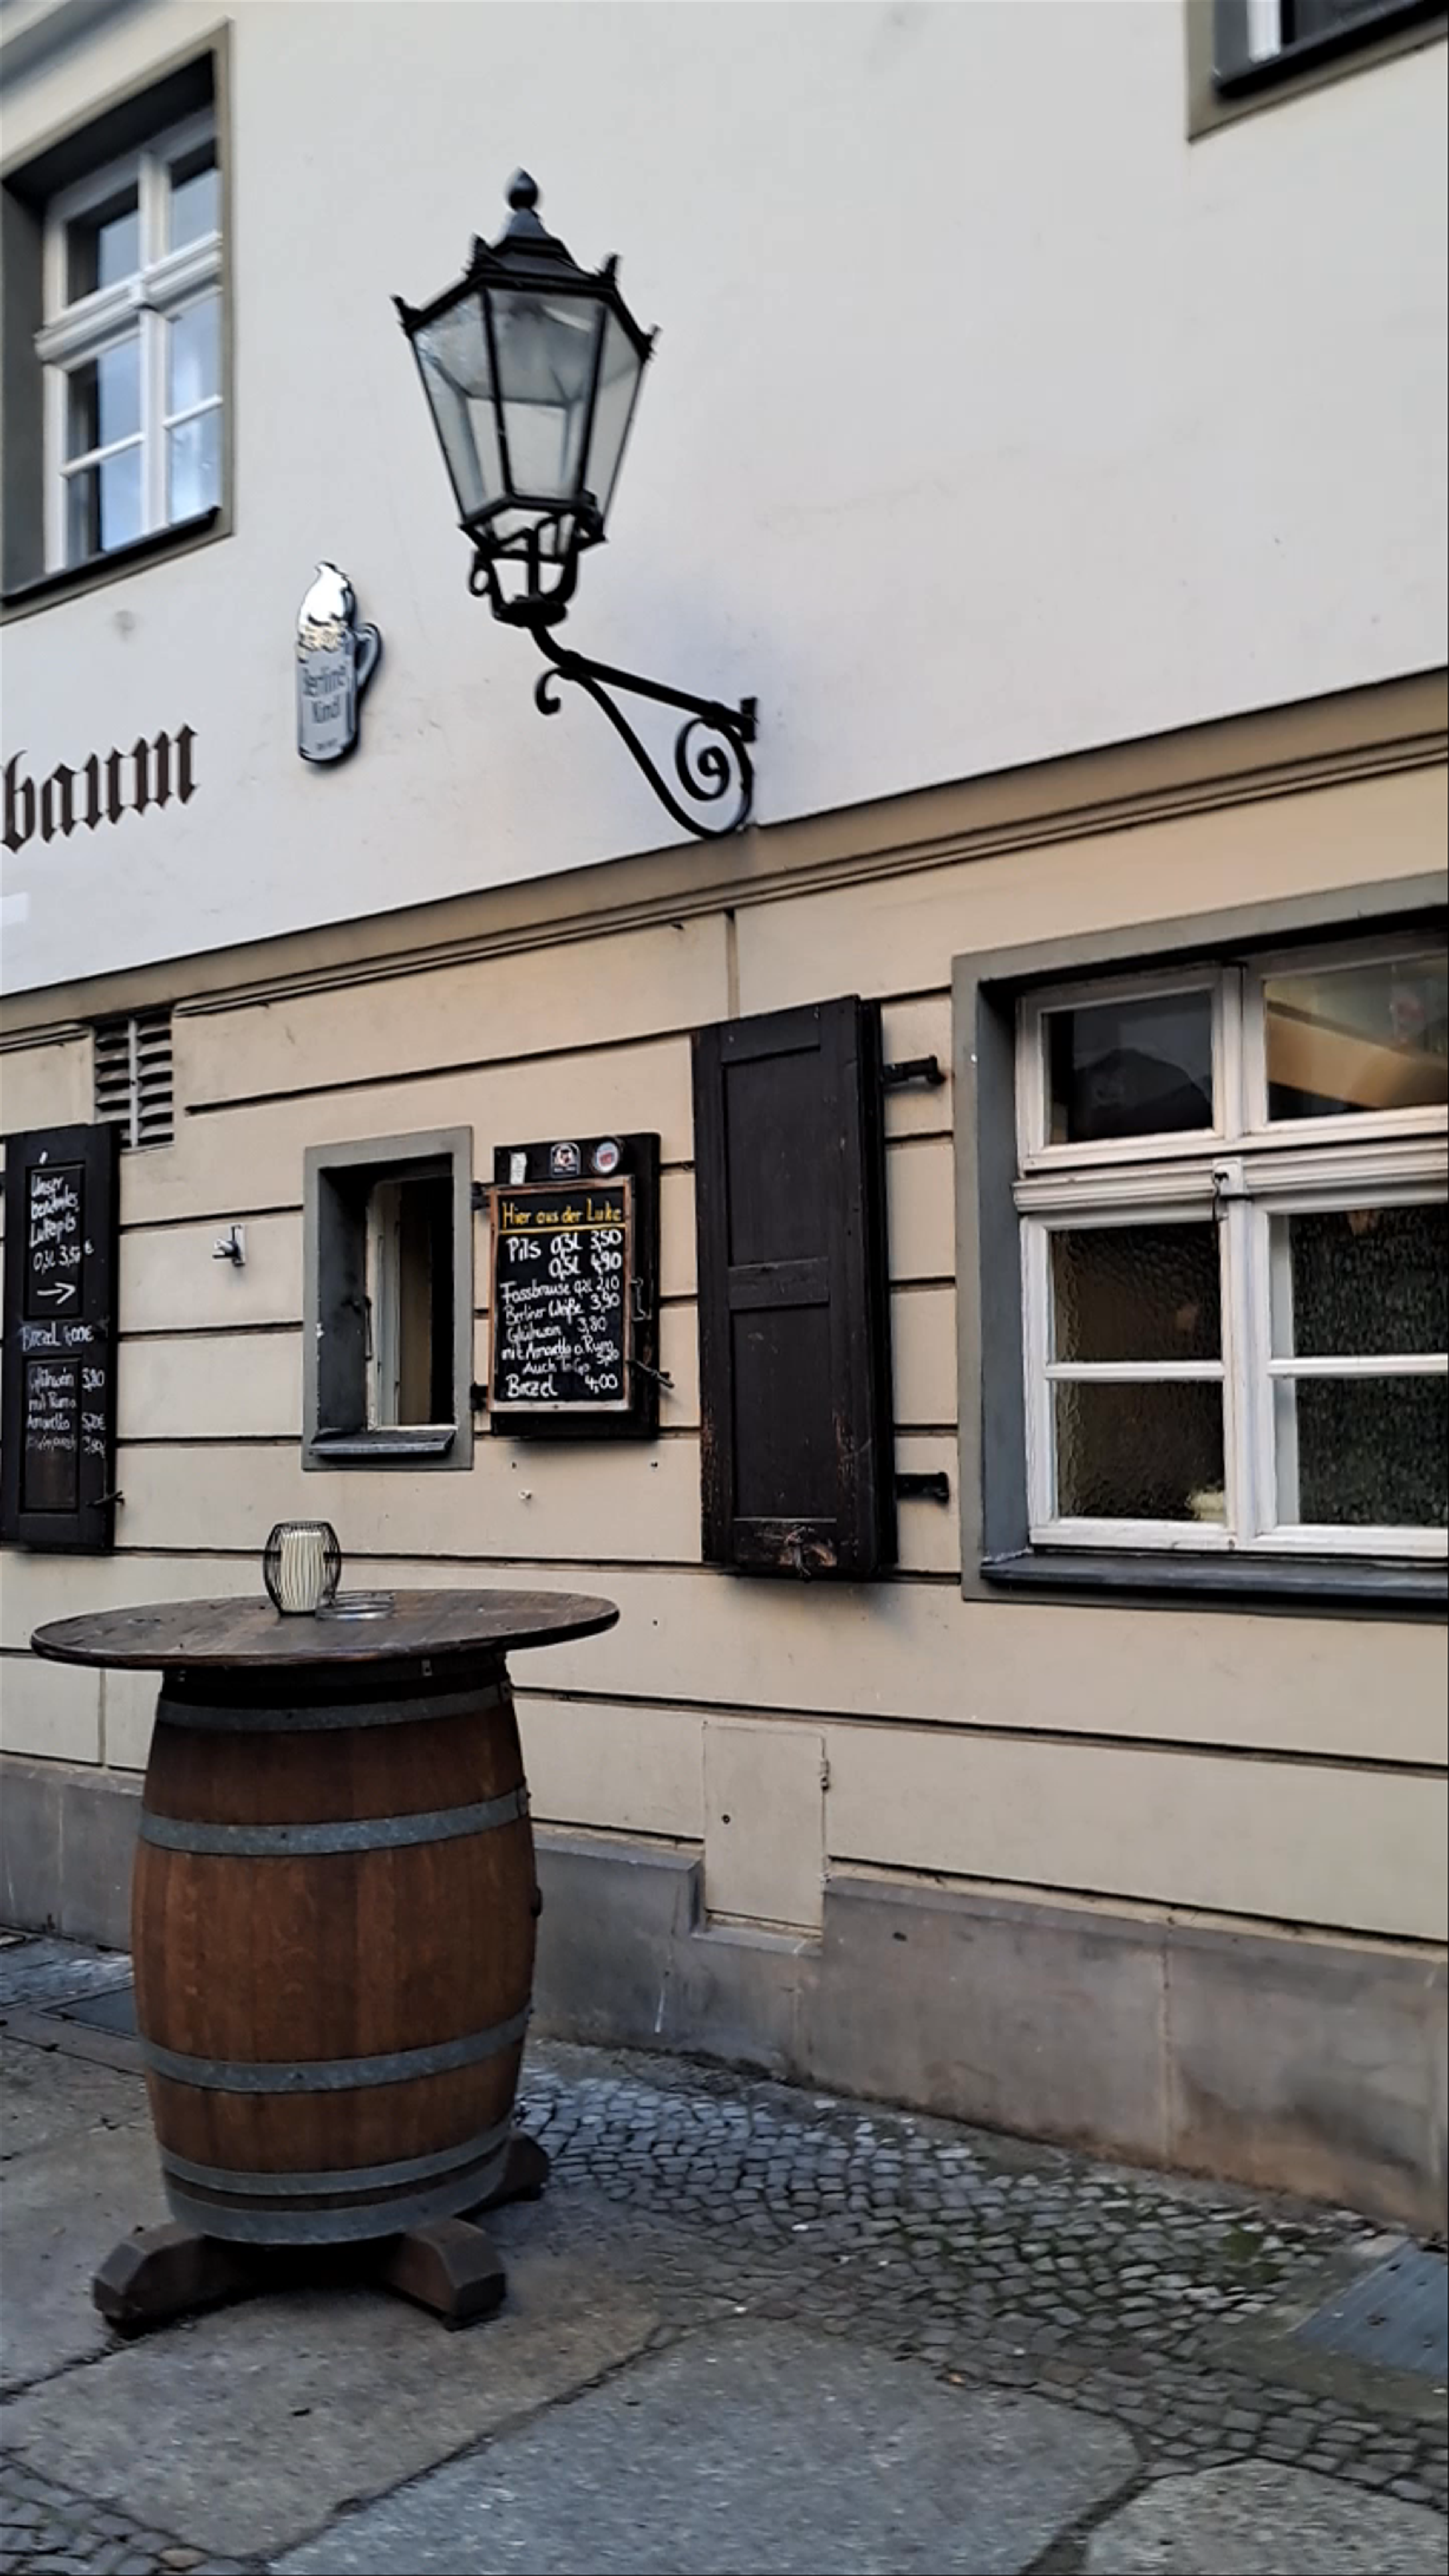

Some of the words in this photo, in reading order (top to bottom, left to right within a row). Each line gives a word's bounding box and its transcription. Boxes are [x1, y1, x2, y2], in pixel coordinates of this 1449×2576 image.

[502, 1201, 531, 1231] Hier
[536, 1211, 559, 1224] aus
[561, 1205, 583, 1224] der
[587, 1197, 622, 1222] Luke
[506, 1236, 542, 1263] Pils
[590, 1229, 622, 1253] 3,50
[590, 1250, 622, 1275] 4,90
[500, 1279, 571, 1304] Fassbrause
[503, 1303, 547, 1326] Berliner
[581, 1335, 614, 1354] Rum
[522, 1358, 557, 1375] Auch
[585, 1373, 618, 1394] 4,00
